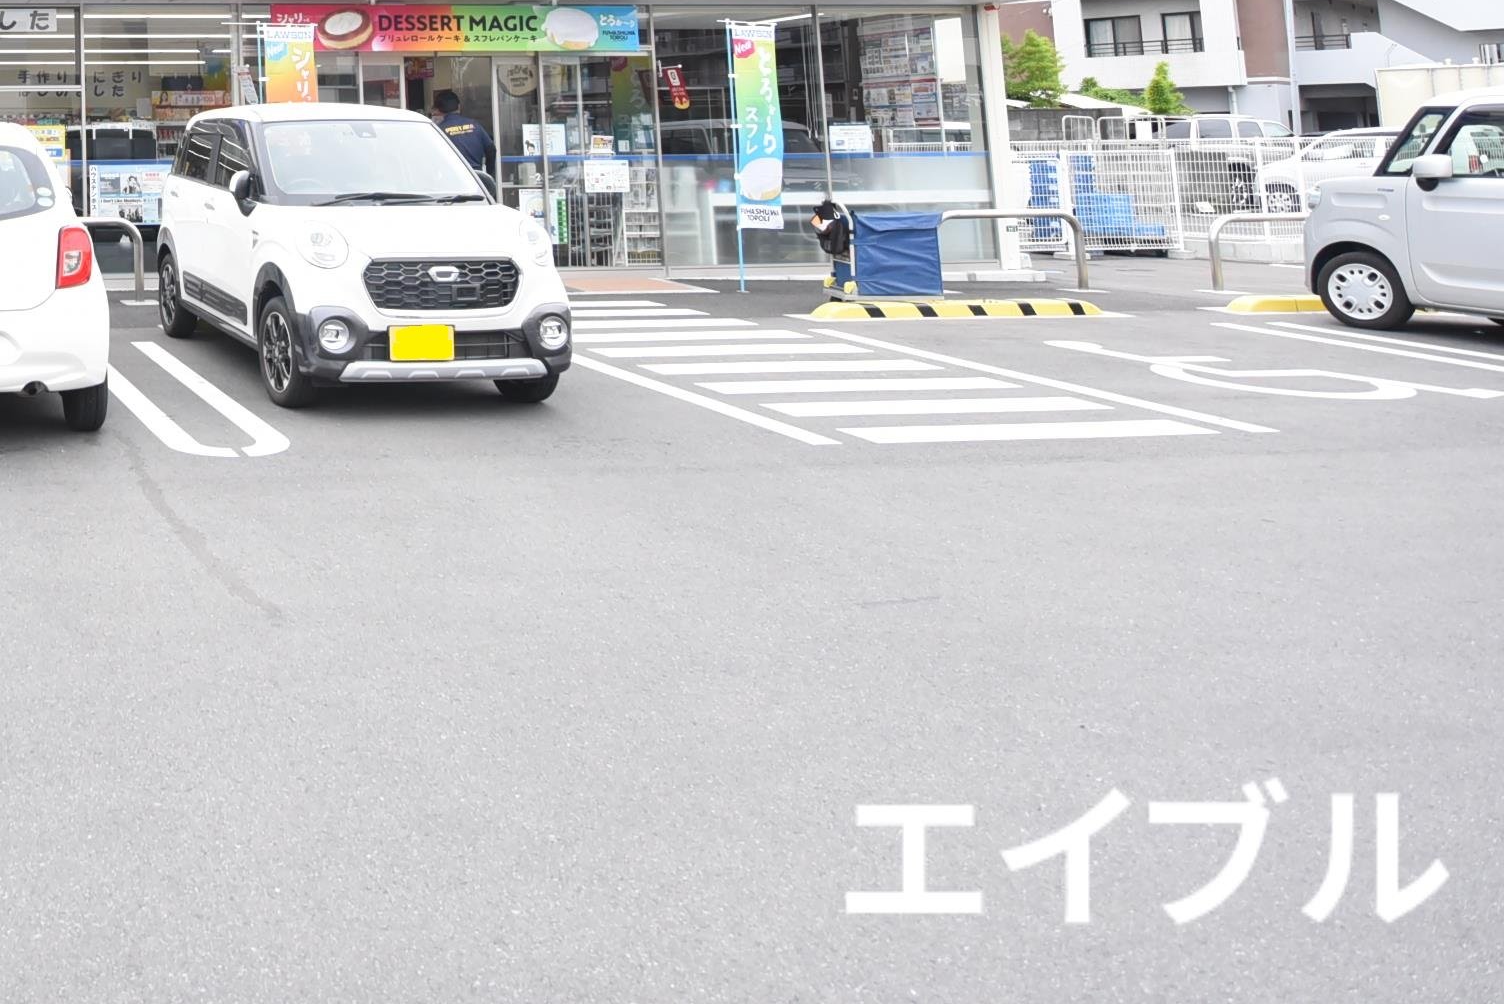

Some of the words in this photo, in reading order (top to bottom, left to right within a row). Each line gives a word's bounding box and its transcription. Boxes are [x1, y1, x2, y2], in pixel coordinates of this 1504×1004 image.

[378, 15, 465, 32] DESSERT
[469, 15, 539, 32] MAGIC
[17, 70, 142, 84] 手作りにぎり
[744, 106, 759, 156] スフレ
